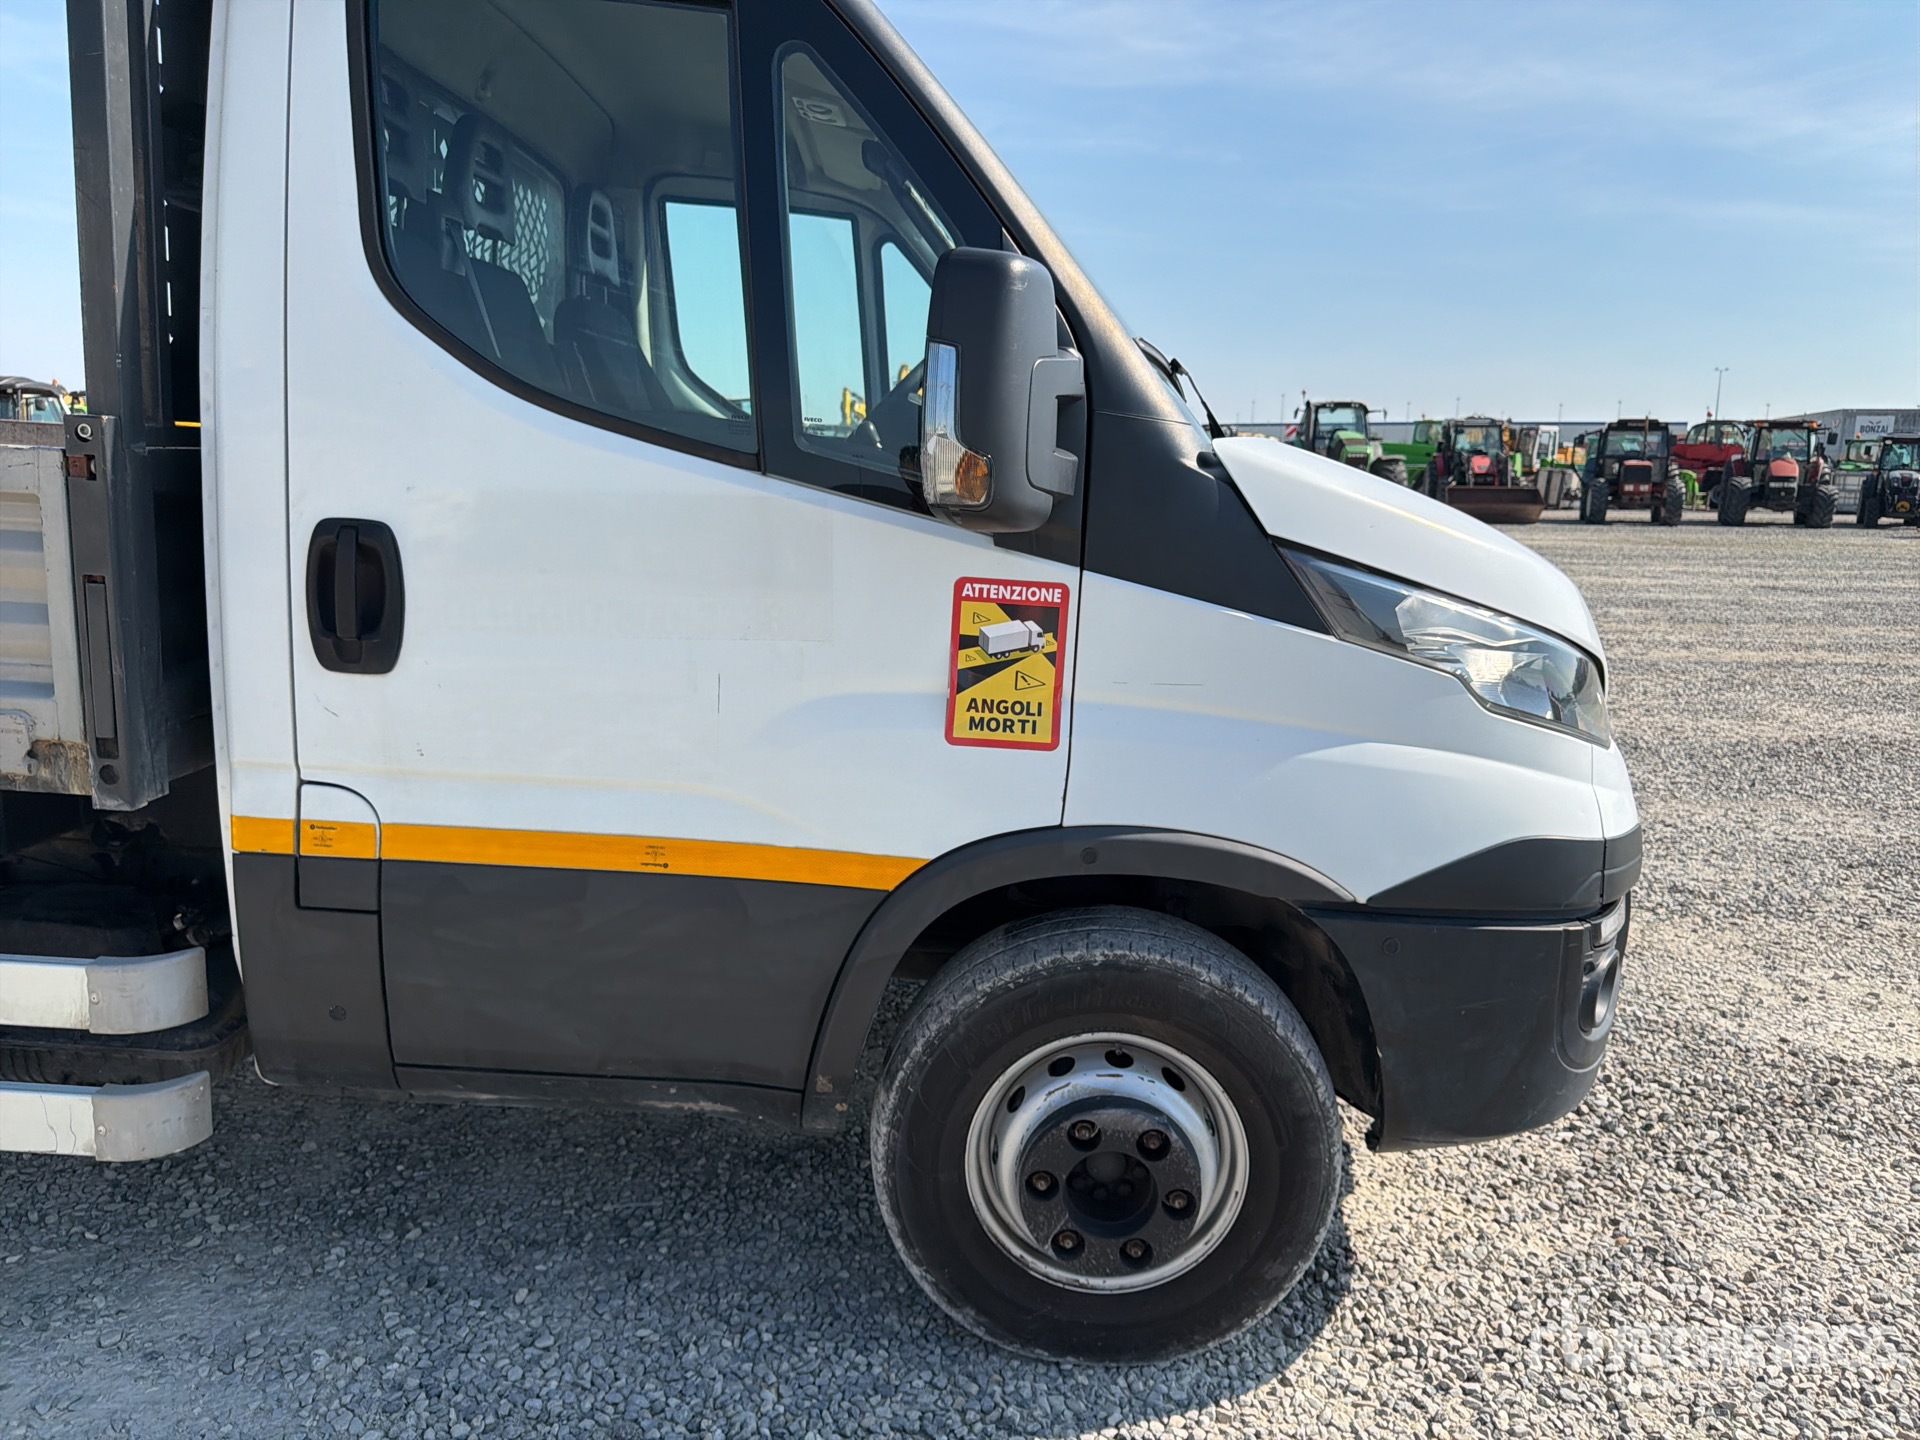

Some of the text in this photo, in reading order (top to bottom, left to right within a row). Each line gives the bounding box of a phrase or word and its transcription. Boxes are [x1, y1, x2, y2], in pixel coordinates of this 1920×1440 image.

[1860, 425, 1889, 433] BONZAI
[962, 583, 1062, 603] ATTENZIONE
[966, 698, 1043, 717] ANGOLI
[968, 716, 1037, 735] MORTI
